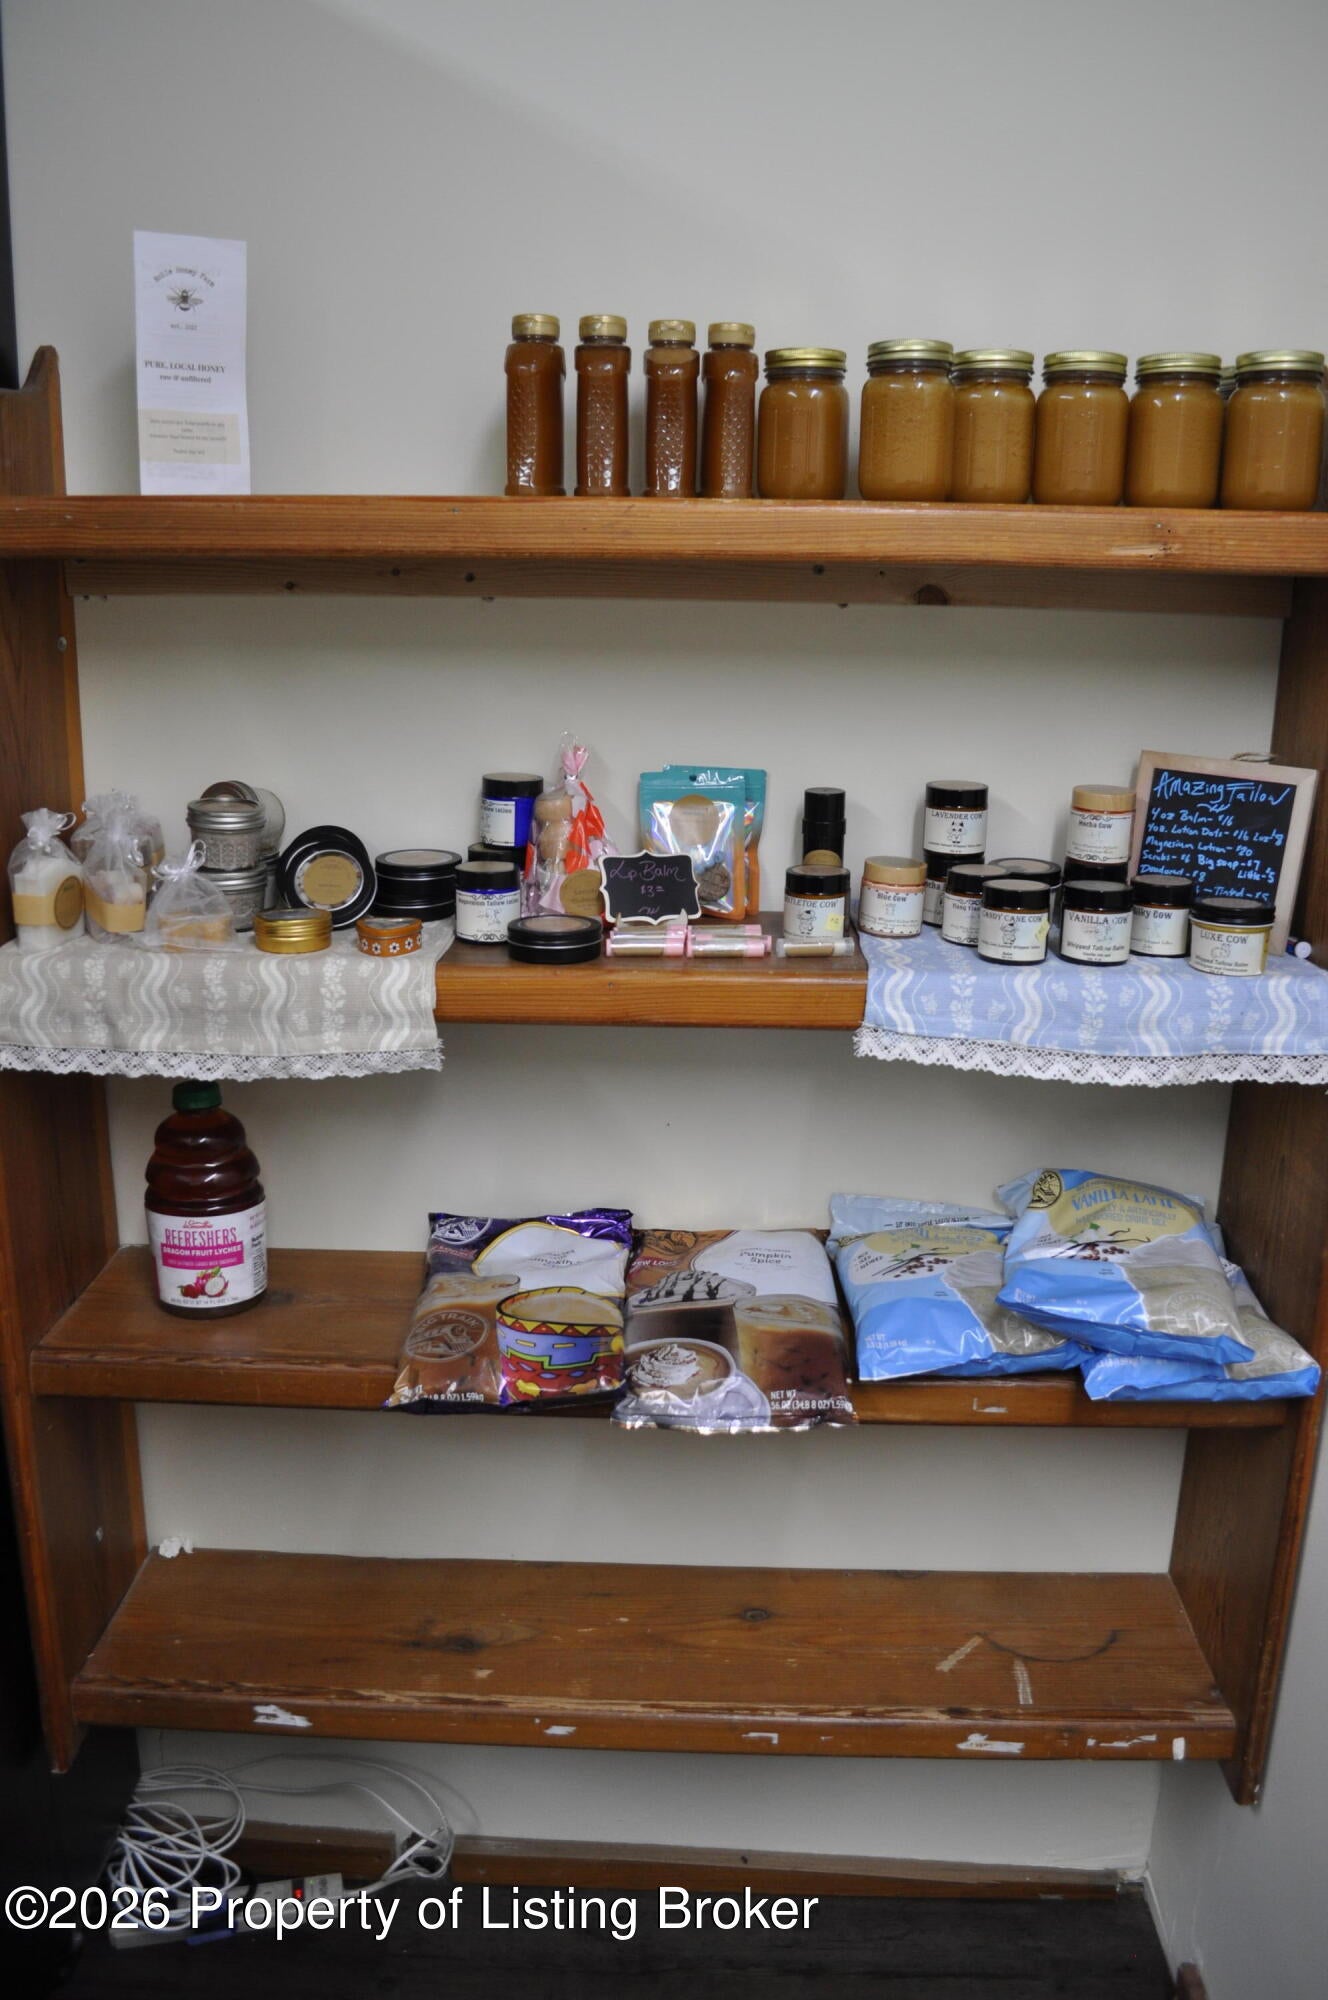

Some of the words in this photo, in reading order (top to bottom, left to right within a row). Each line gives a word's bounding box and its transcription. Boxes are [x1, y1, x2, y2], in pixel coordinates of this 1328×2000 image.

[143, 359, 168, 369] PURE,
[170, 361, 196, 371] LOCAL
[197, 363, 227, 374] HONEY
[1153, 771, 1224, 804] Amazing
[1225, 781, 1290, 806] Tallow
[931, 810, 969, 820] LAVENDER
[1145, 835, 1194, 853] Magnesium
[1196, 853, 1215, 871] Big
[876, 892, 892, 900] Blue
[1004, 915, 1027, 923] CANE
[1068, 911, 1109, 925] VANILLA
[1153, 910, 1173, 920] Cow
[1199, 929, 1224, 943] LUXE
[1225, 934, 1249, 945] COW
[1071, 1188, 1129, 1212] VANILLA
[164, 1227, 237, 1248] REFRESHERS
[162, 1246, 191, 1256] DRAGON
[191, 1247, 214, 1257] FRUIT
[214, 1244, 242, 1256] LYCHEE
[439, 1312, 481, 1329] TRAIN
[770, 1390, 784, 1400] NET
